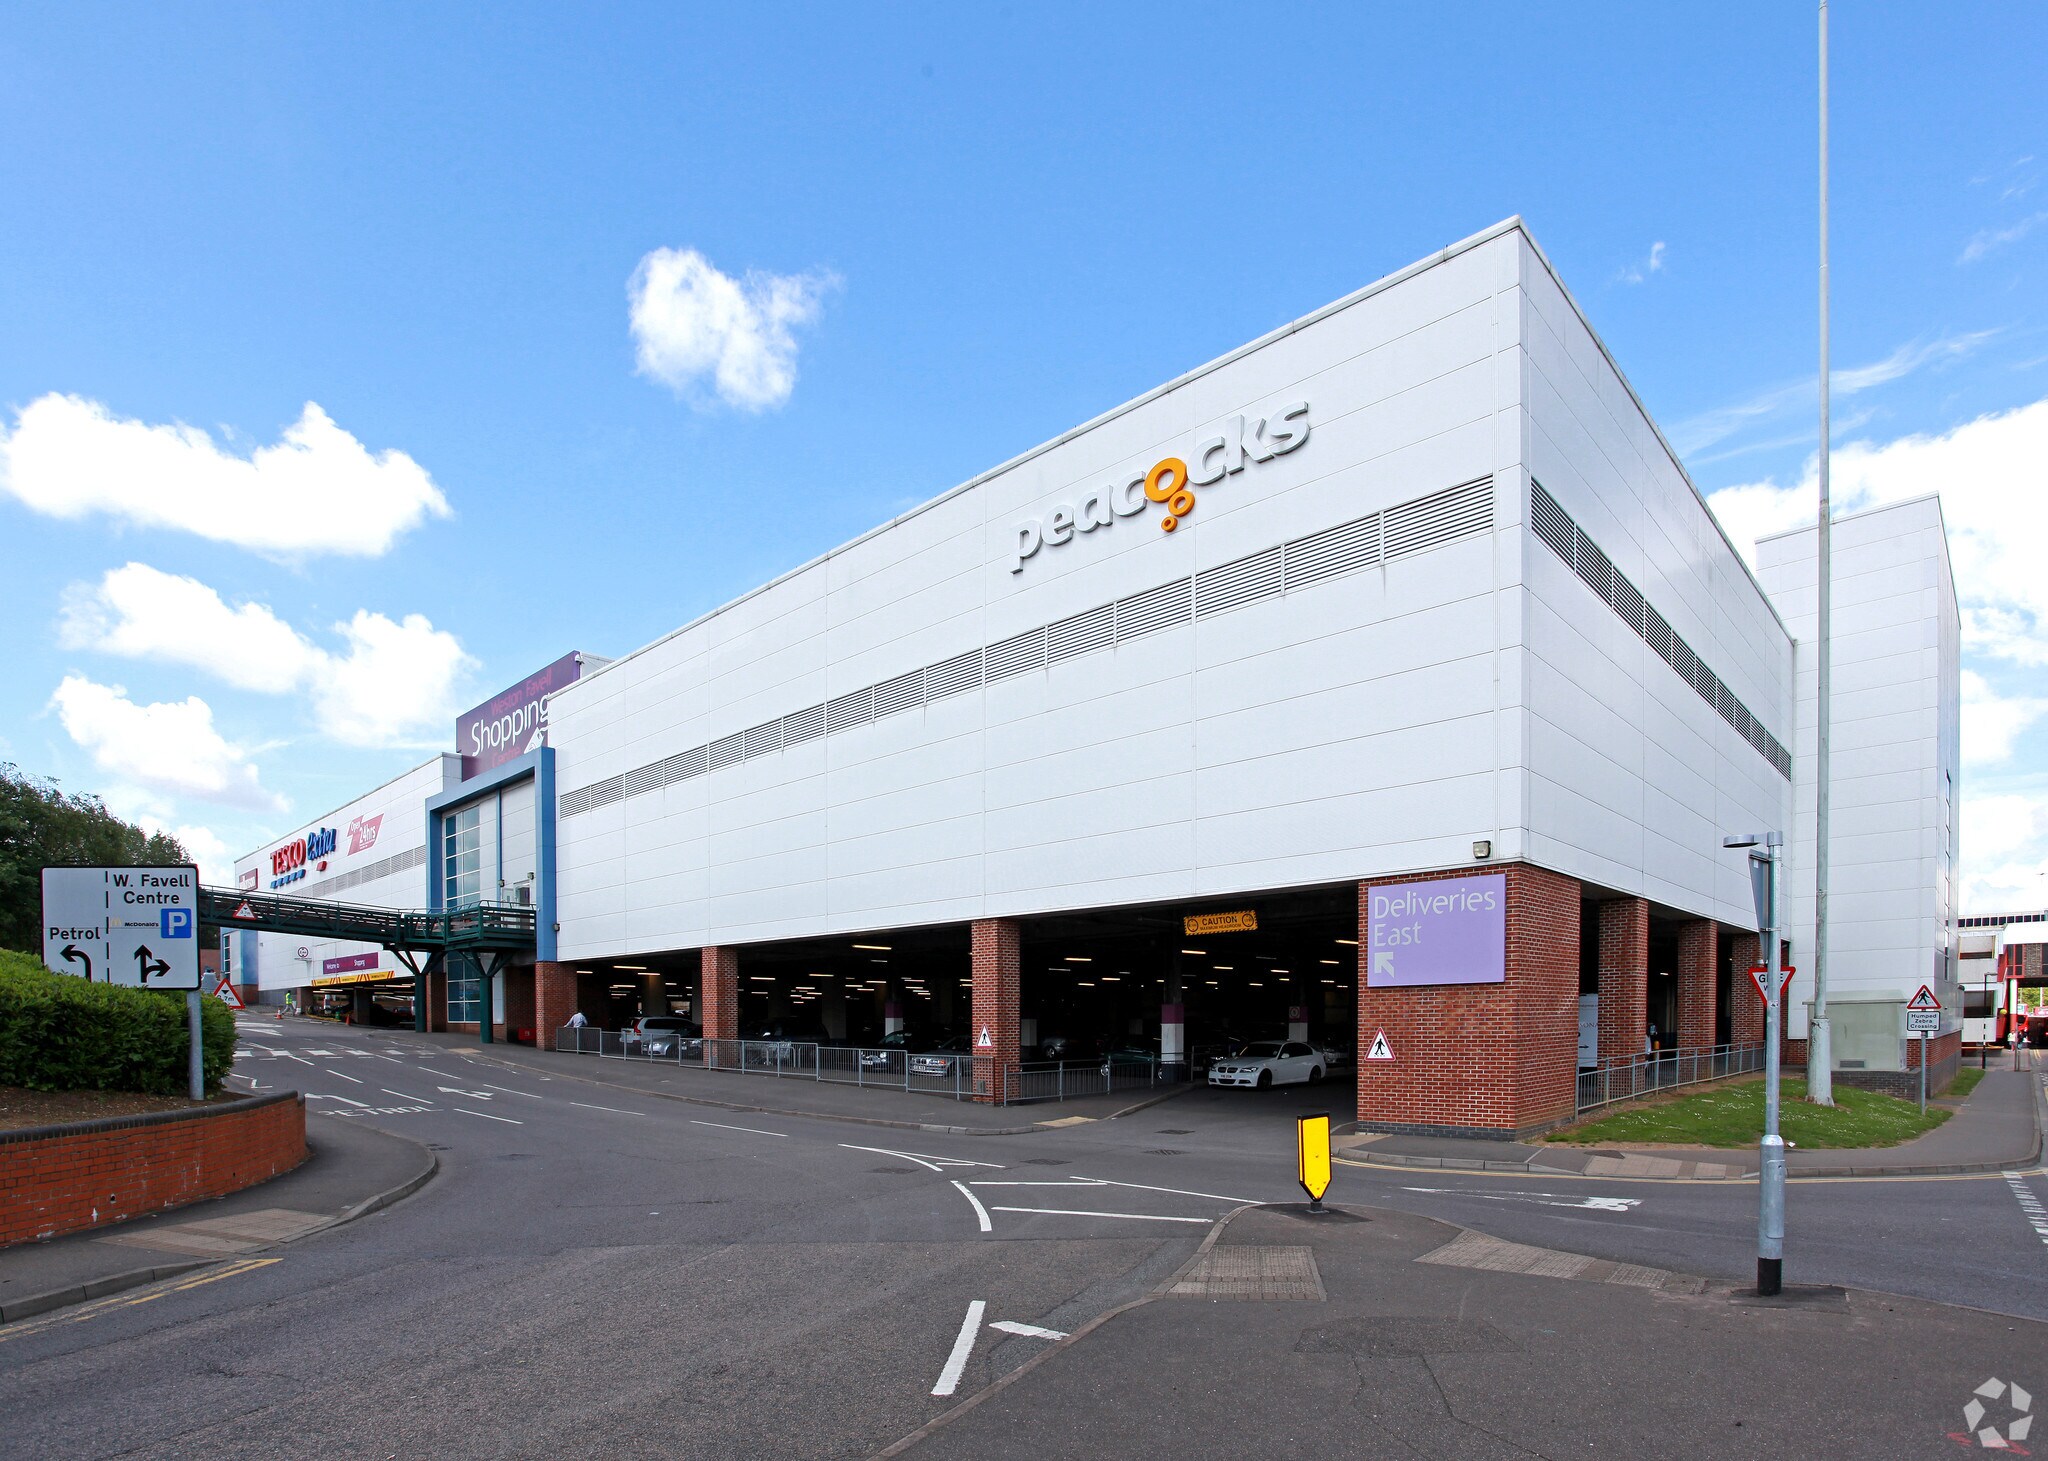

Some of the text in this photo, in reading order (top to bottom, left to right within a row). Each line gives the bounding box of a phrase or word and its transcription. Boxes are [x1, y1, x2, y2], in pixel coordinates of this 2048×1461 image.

[1009, 400, 1310, 574] peacocks
[491, 668, 552, 716] Weston Favell
[471, 693, 550, 757] Shopping
[270, 827, 337, 876] TESCO extra
[113, 874, 190, 887] W. Favell
[123, 891, 180, 904] Centre
[1374, 887, 1496, 919] Deliveries
[50, 927, 100, 940] Petrol
[168, 911, 187, 936] P
[1201, 915, 1238, 926] CAUTION
[1374, 920, 1422, 947] East
[317, 1105, 444, 1117] PETROL
